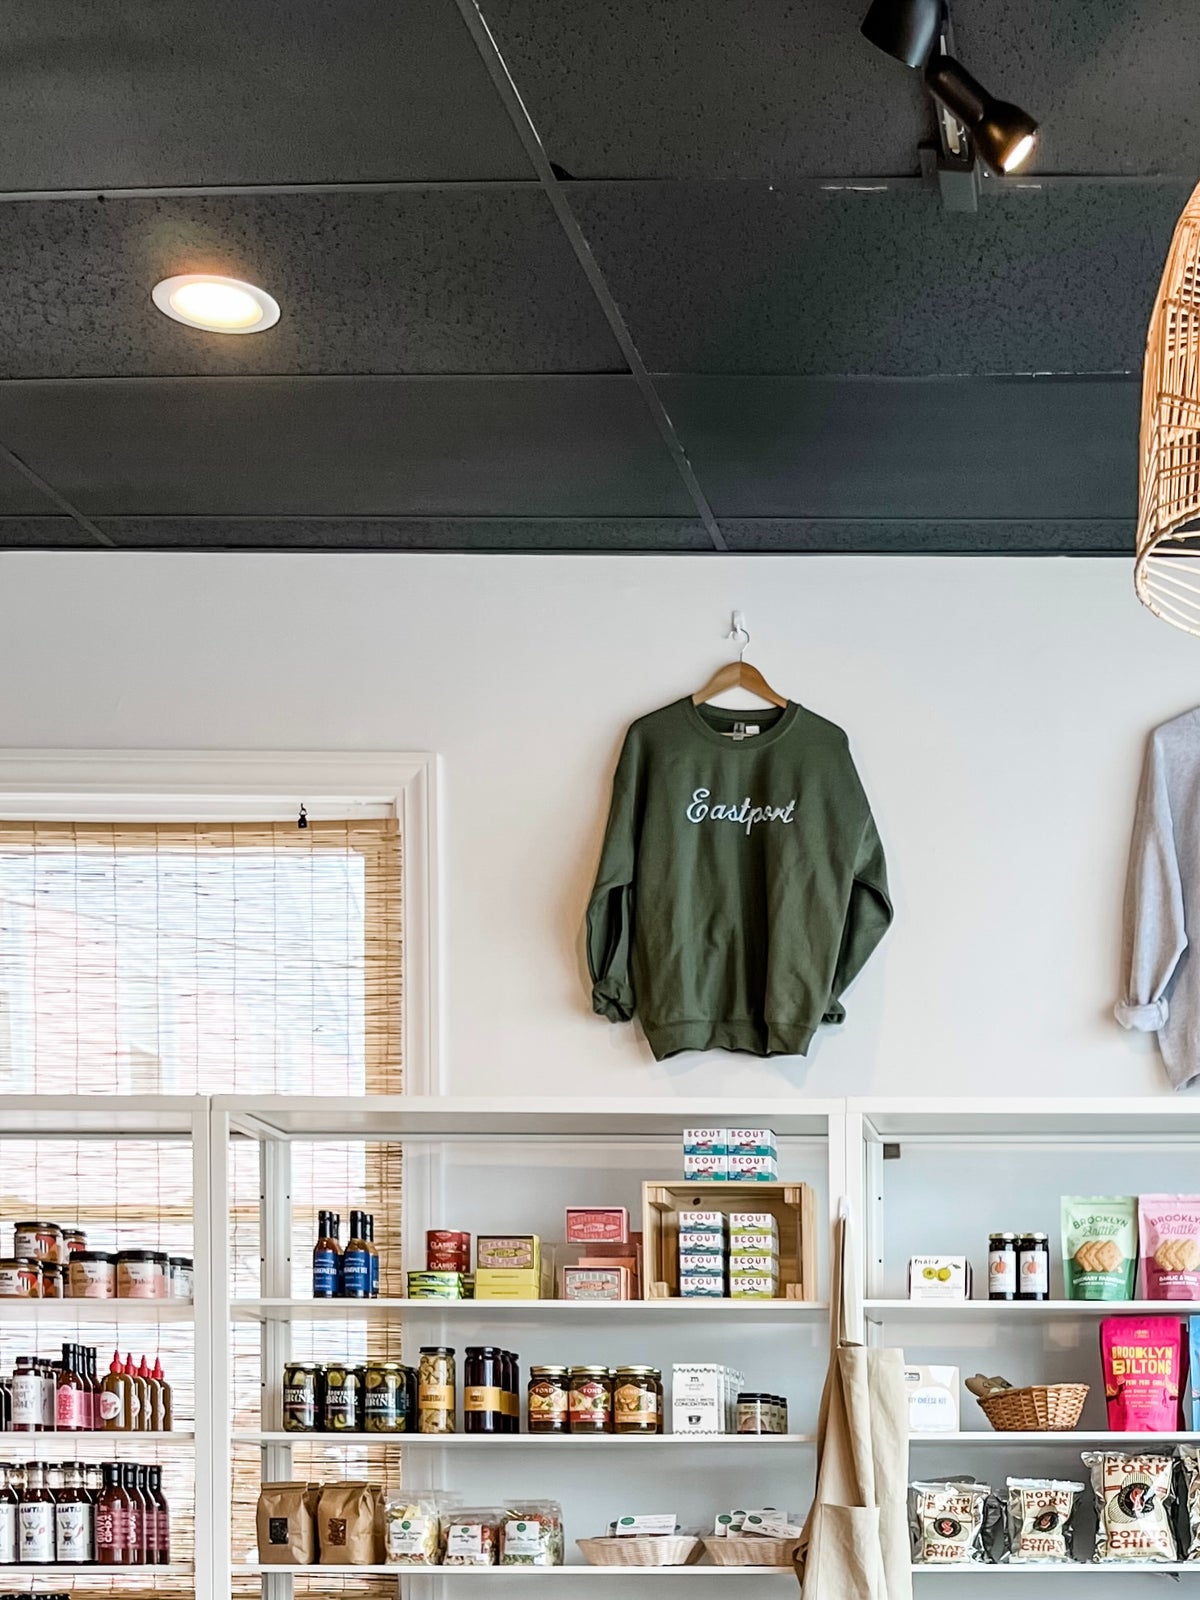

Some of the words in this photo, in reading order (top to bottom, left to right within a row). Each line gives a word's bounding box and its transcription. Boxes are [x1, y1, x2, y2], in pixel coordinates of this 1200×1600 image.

[687, 788, 795, 835] Eastport
[687, 1130, 721, 1138] SCOUT
[688, 1157, 722, 1165] SCOUT
[732, 1157, 766, 1165] SCOUT
[1073, 1216, 1128, 1230] BROOKLYN
[1160, 1223, 1198, 1236] Brittle
[734, 1236, 768, 1244] SCOUT
[430, 1241, 458, 1249] CLASSIC
[684, 1256, 718, 1264] SCOUT
[734, 1278, 768, 1286] SCOUT
[1112, 1346, 1172, 1359] BROOKLYN
[1112, 1359, 1172, 1376] BILTONG
[1105, 1463, 1168, 1477] FORK
[1025, 1490, 1069, 1499] NORTH
[928, 1494, 970, 1505] NRTH
[1026, 1499, 1068, 1509] FORK
